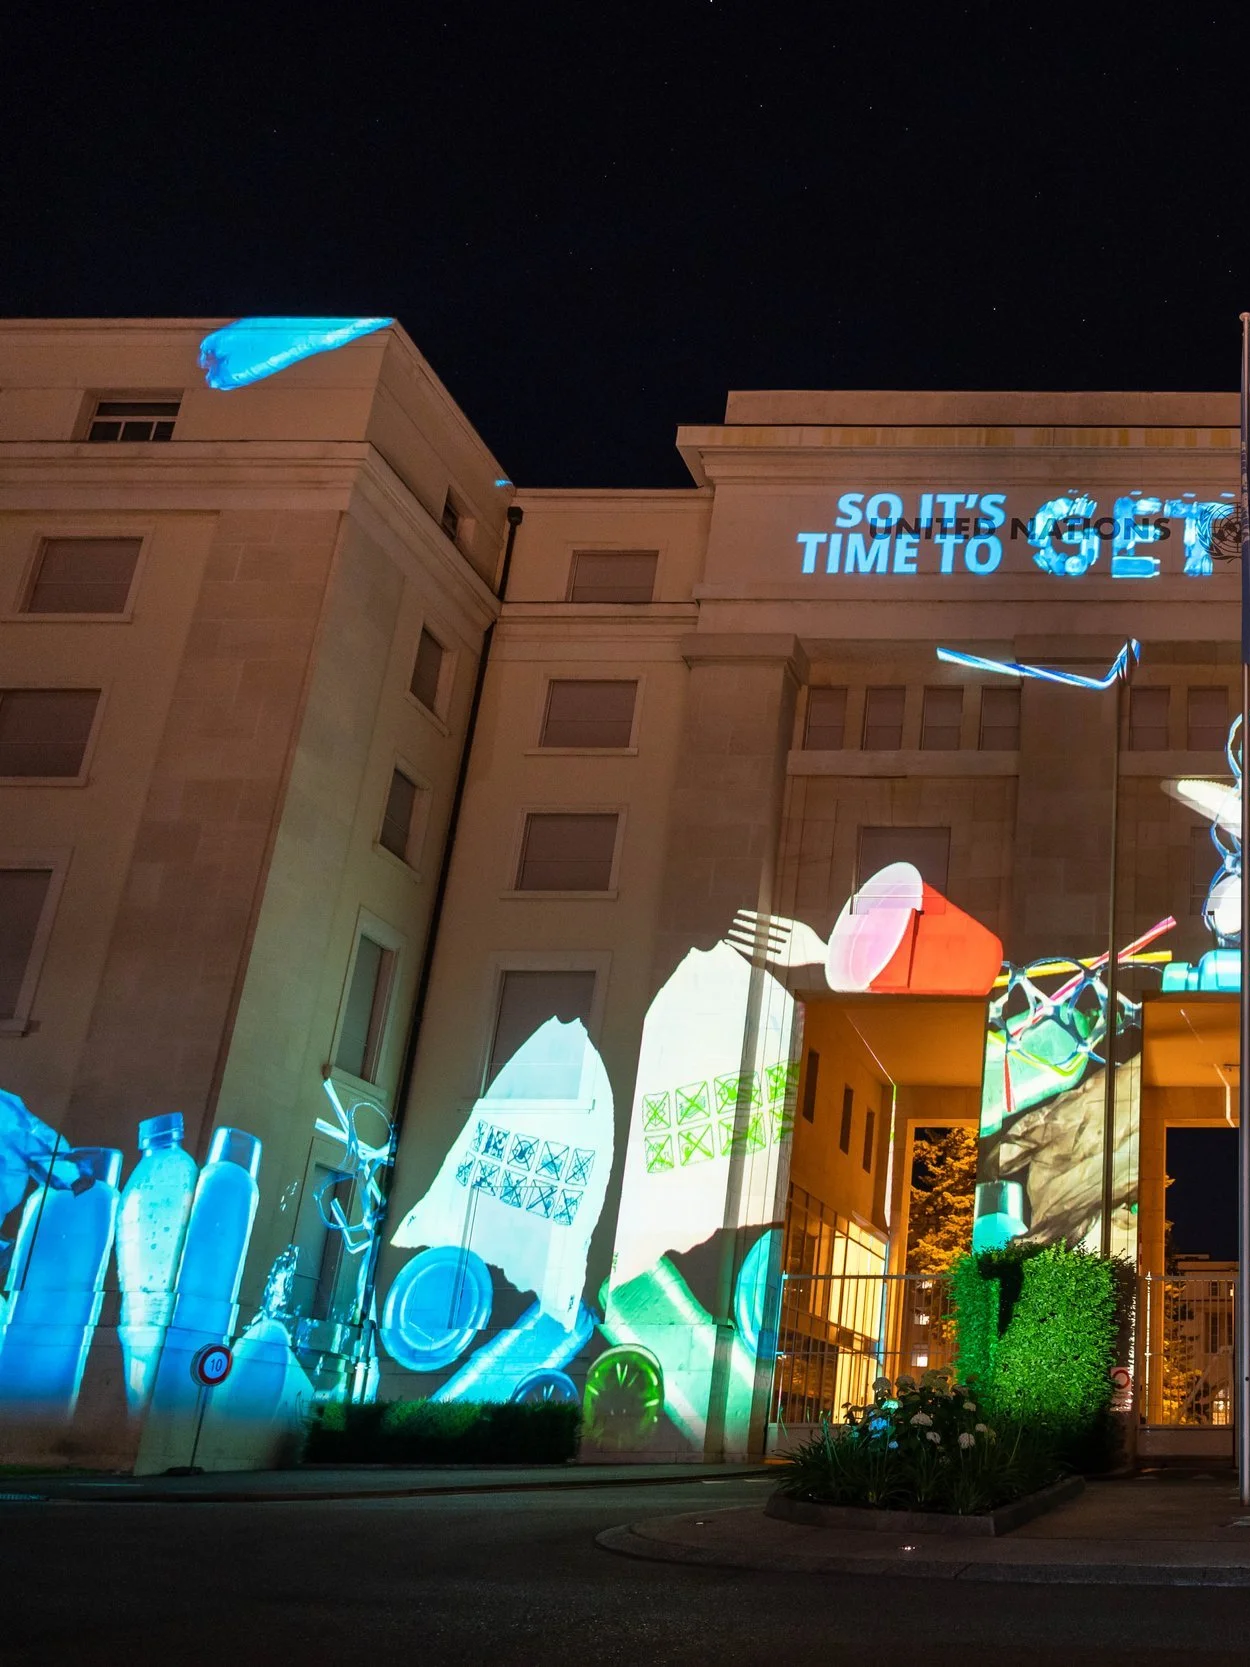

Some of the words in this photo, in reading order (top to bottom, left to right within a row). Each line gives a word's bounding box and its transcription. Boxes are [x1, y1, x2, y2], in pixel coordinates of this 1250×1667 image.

[835, 492, 904, 528] SO
[919, 493, 1007, 529] IT'S
[869, 517, 996, 541] UNITED
[1010, 517, 1172, 541] NATIONS
[797, 532, 921, 575] TIME
[934, 532, 1004, 575] TO
[1027, 494, 1236, 579] GET
[210, 1358, 223, 1373] 10
